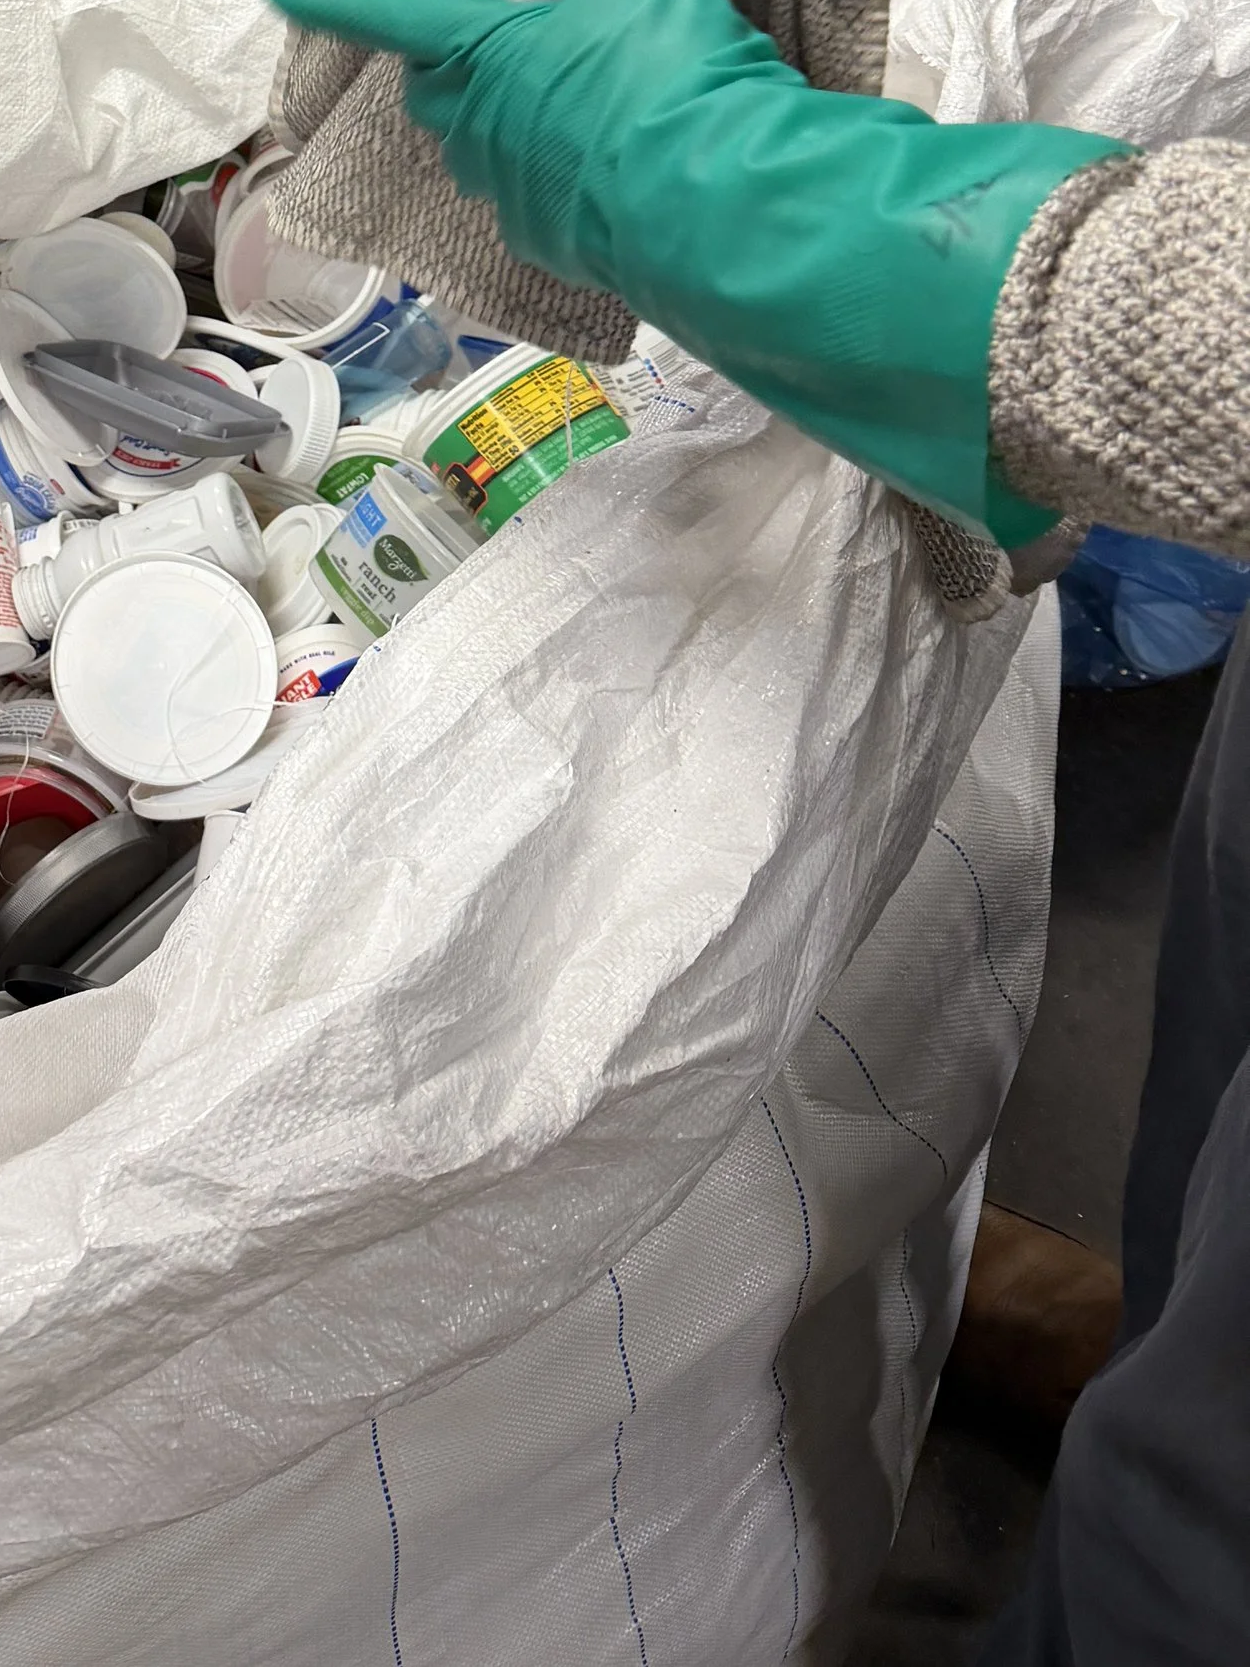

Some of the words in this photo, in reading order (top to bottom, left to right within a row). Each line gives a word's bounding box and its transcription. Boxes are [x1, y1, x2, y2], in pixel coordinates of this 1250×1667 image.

[460, 408, 488, 430] Nutrition
[464, 422, 485, 438] Facts
[336, 473, 370, 499] LOWFAT
[379, 537, 418, 580] Marzetti
[358, 562, 397, 604] ranch
[361, 582, 378, 601] real
[359, 606, 375, 626] dip
[280, 661, 293, 674] MADE
[281, 676, 311, 702] IANT
